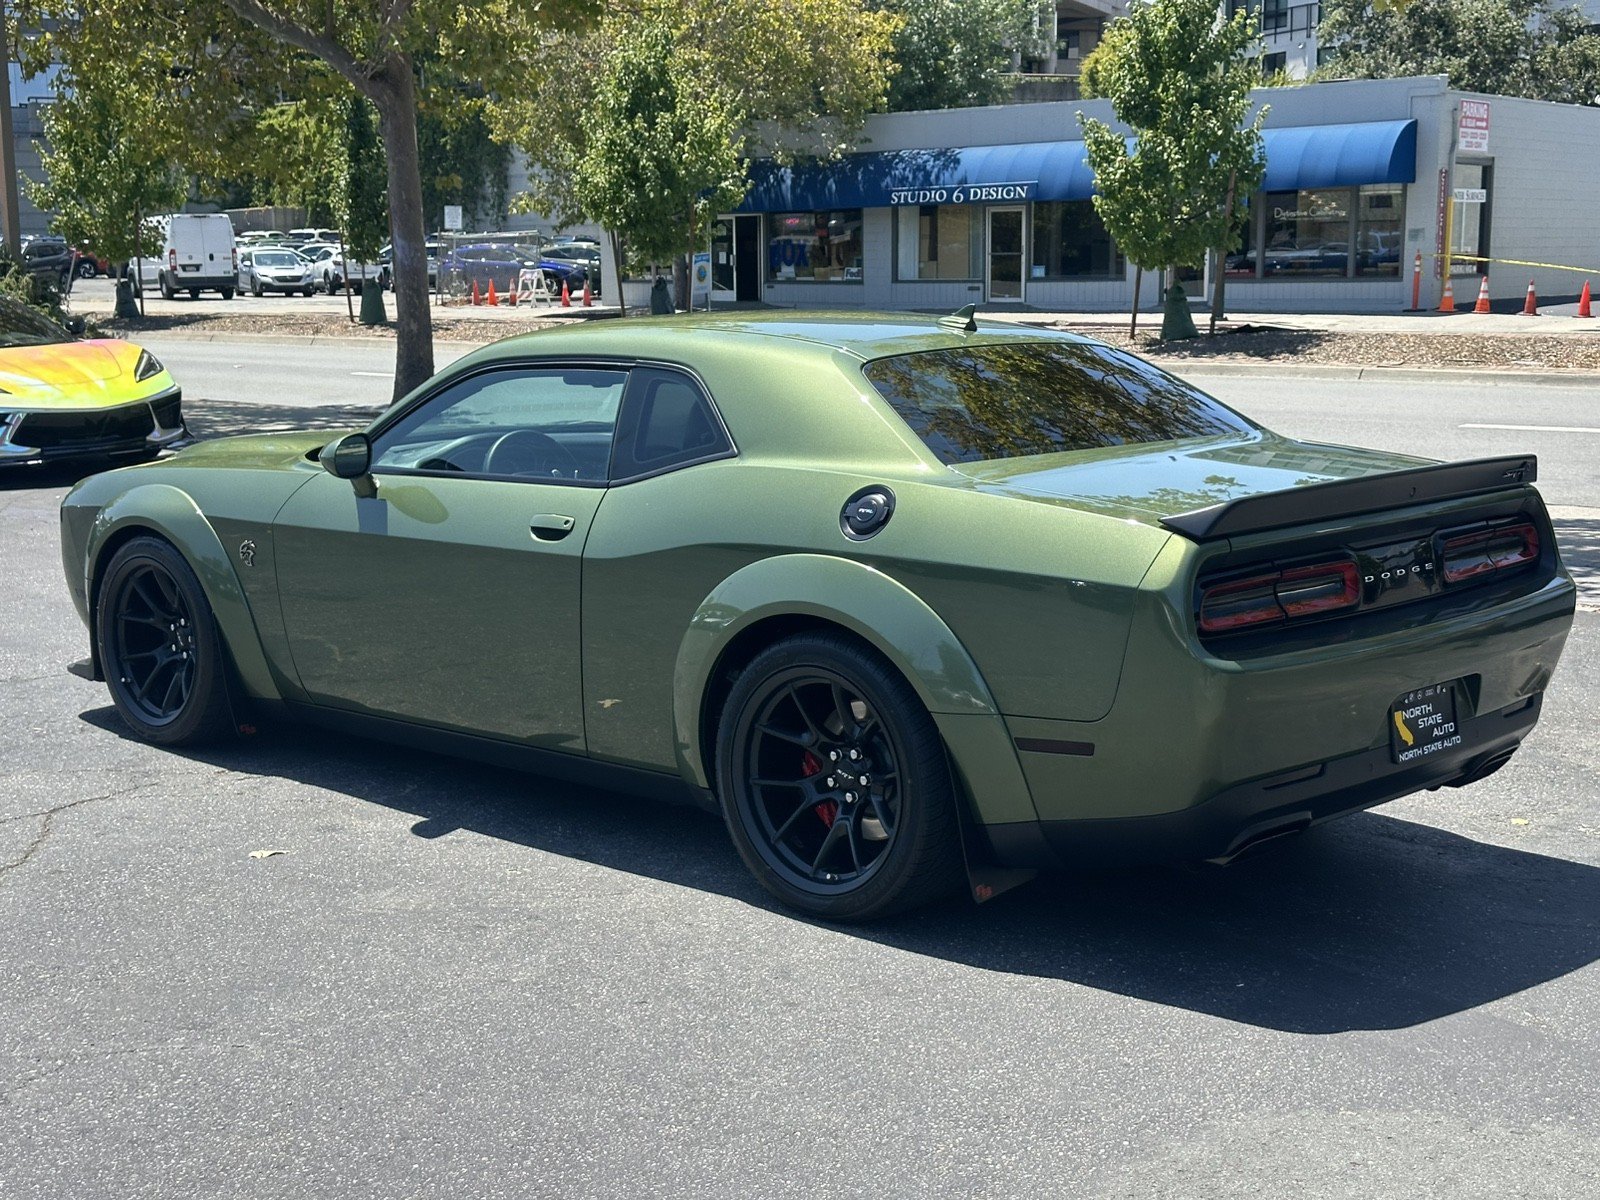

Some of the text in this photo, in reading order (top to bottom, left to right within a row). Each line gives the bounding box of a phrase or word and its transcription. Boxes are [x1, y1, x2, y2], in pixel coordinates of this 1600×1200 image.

[1462, 101, 1488, 119] PARKING
[890, 185, 1029, 204] STUDIO 6 DESIGN
[1364, 562, 1434, 583] DODGE
[1402, 703, 1433, 719] NORTH
[1417, 713, 1443, 729] STATE
[1432, 722, 1455, 738] AUTO
[1399, 735, 1462, 762] NORTH STATE AUTO
